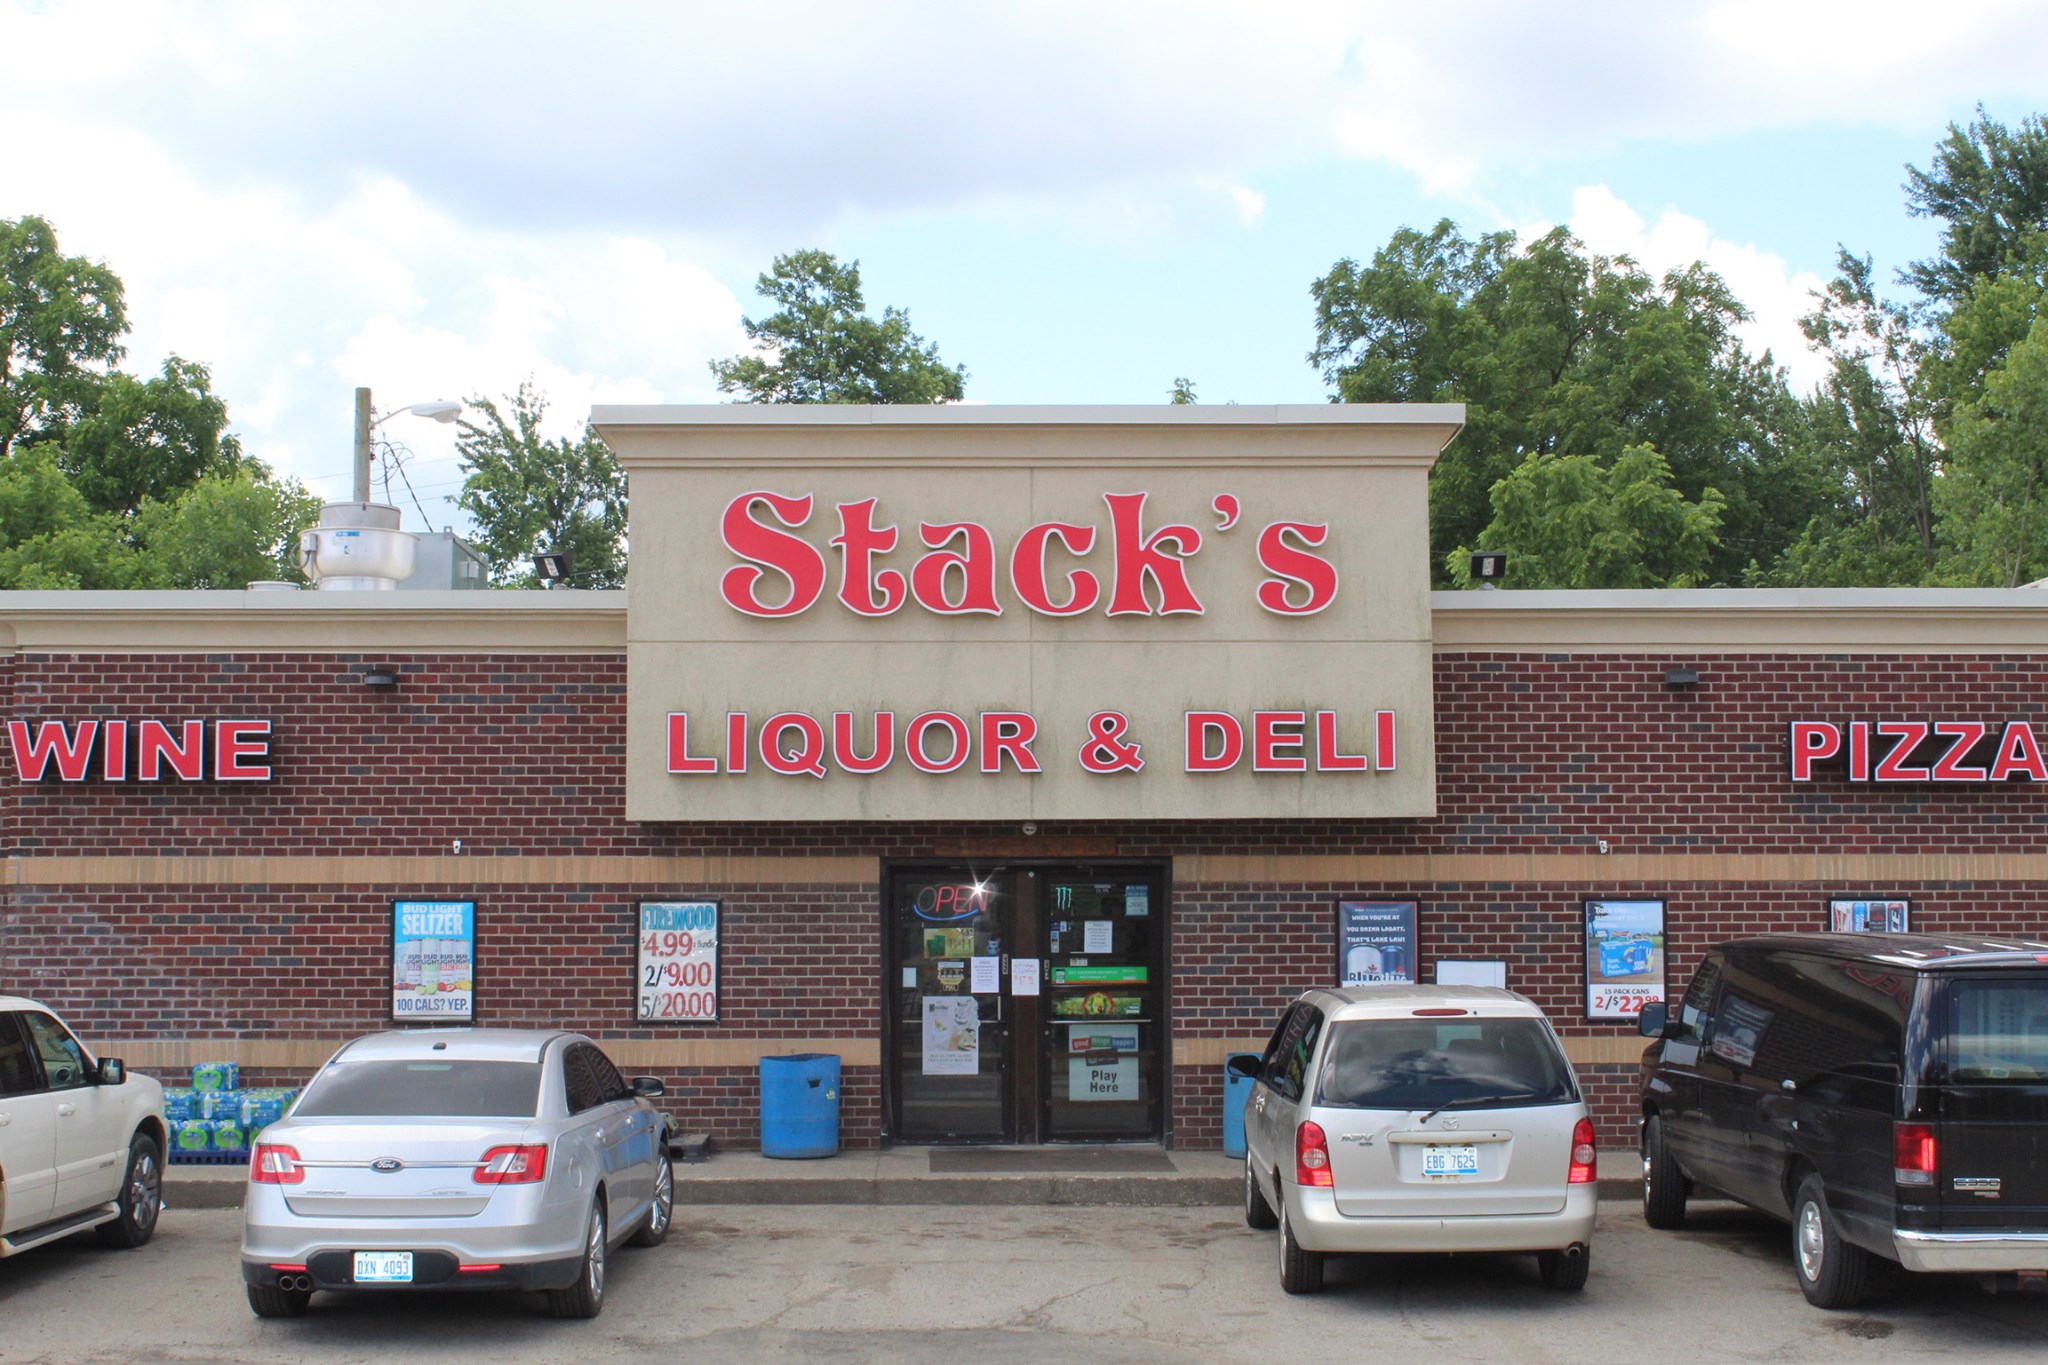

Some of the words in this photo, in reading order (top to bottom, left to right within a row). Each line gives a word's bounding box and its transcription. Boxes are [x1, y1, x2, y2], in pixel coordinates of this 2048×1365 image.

[719, 489, 1339, 618] Stack's
[7, 719, 271, 781] WINE
[666, 710, 1042, 779] LIQUOR
[1078, 709, 1146, 774] &
[1184, 708, 1397, 772] DELI
[1791, 721, 2048, 781] PIZZA
[402, 905, 427, 913] BUD
[428, 905, 463, 913] LIGHT
[918, 886, 988, 912] OPEN
[402, 913, 463, 935] SELTZER
[641, 905, 716, 930] FIREWOOD
[641, 932, 693, 957] $4.99
[397, 999, 413, 1011] 100
[415, 999, 445, 1011] CALS?
[447, 999, 469, 1011] YEP.
[1090, 1083, 1119, 1092] Here
[1091, 1070, 1118, 1083] Play
[377, 1160, 396, 1169] Ford
[1426, 1155, 1445, 1168] EBG
[1450, 1154, 1475, 1168] 7625
[357, 1260, 376, 1275] DXN
[383, 1260, 409, 1275] 4093
